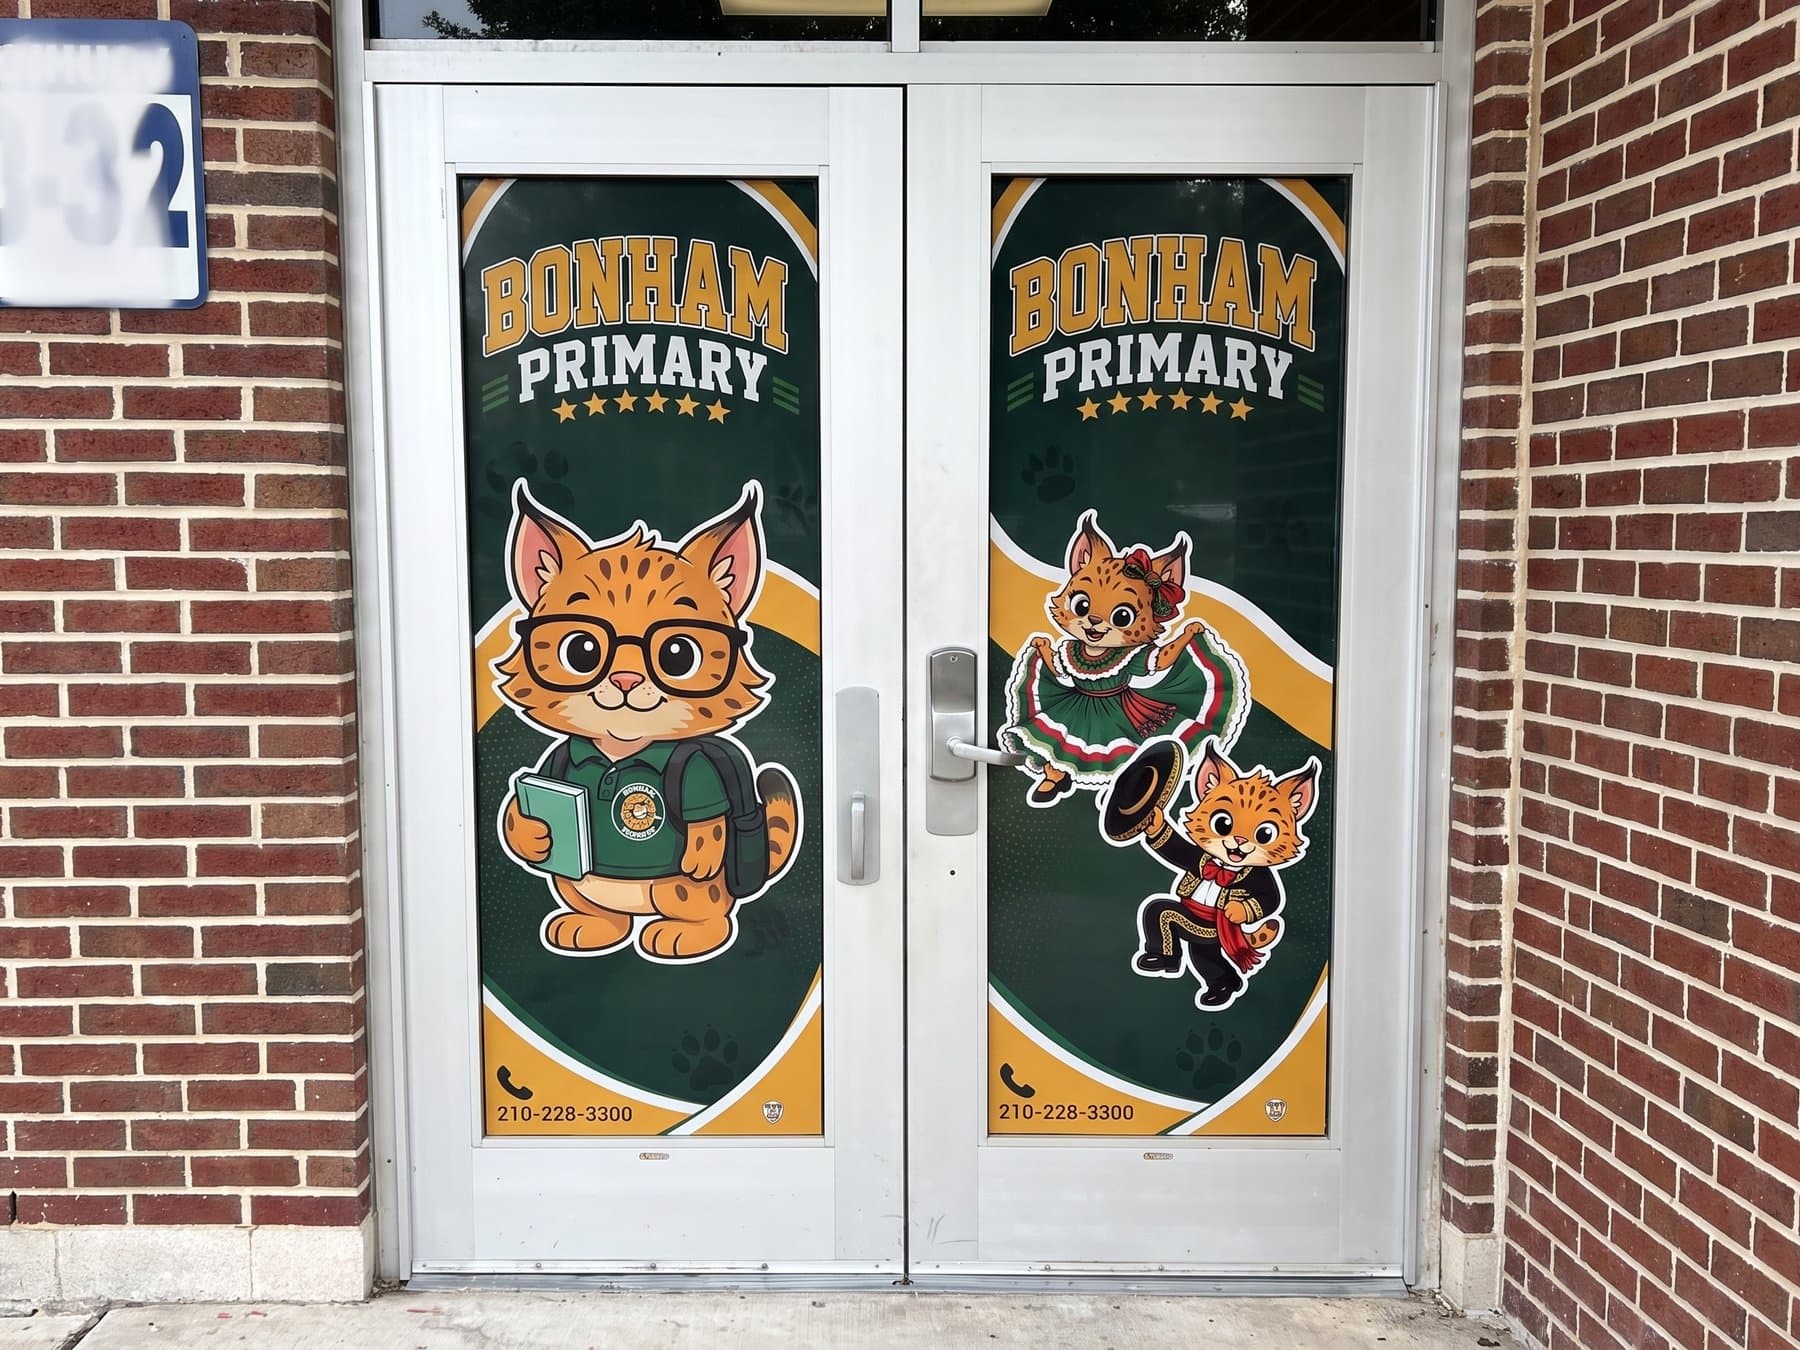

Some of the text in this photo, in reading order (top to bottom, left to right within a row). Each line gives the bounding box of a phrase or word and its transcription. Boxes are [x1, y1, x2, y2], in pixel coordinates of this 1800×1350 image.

[481, 235, 789, 358] BONHAM
[1009, 234, 1318, 358] BONHAM
[517, 334, 768, 404] PRIMARY
[1042, 333, 1294, 403] PRIMARY
[497, 1105, 633, 1122] 210-228-3300
[999, 1103, 1134, 1121] 210-228-3300
